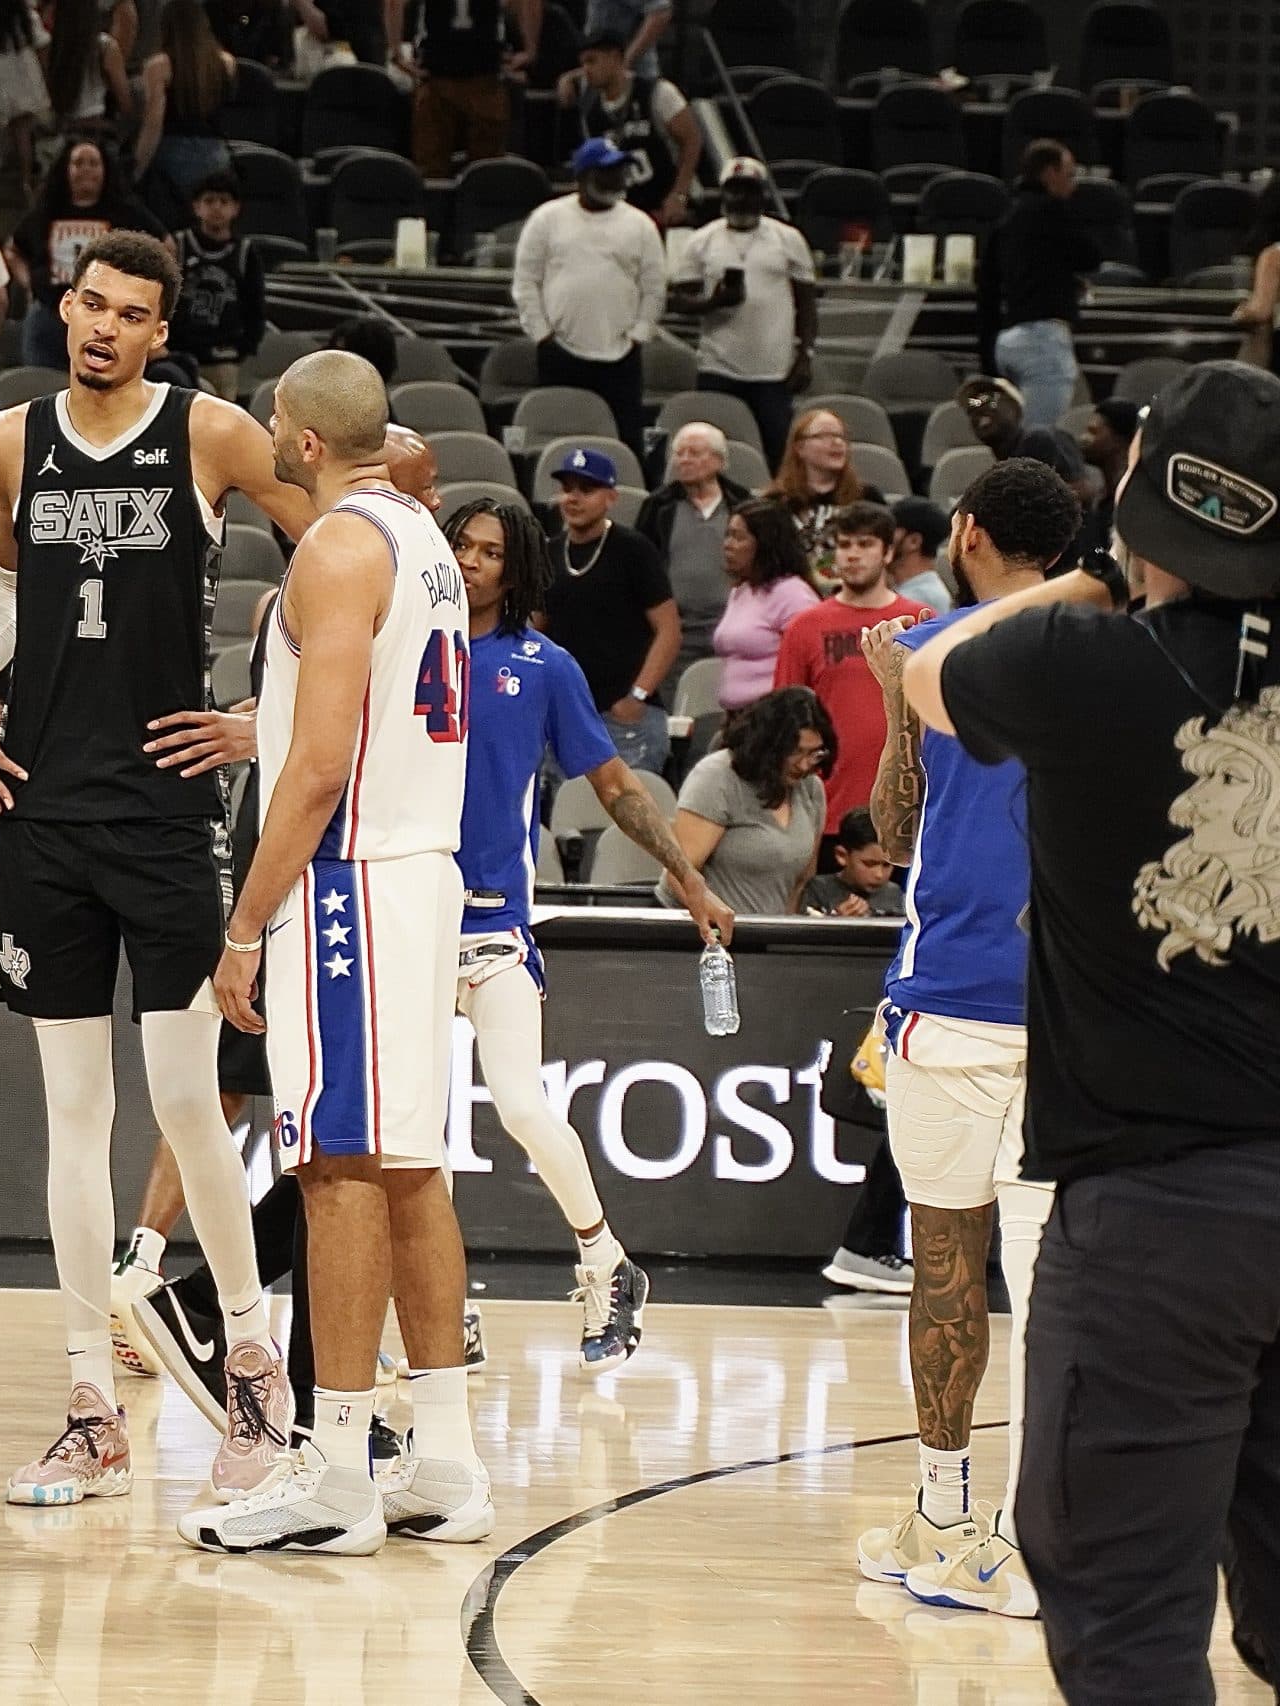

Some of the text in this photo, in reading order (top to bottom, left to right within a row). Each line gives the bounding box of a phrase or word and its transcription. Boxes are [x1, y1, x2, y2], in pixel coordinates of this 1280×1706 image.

[134, 449, 170, 465] Self.
[30, 488, 173, 550] SATX
[77, 578, 107, 639] 1
